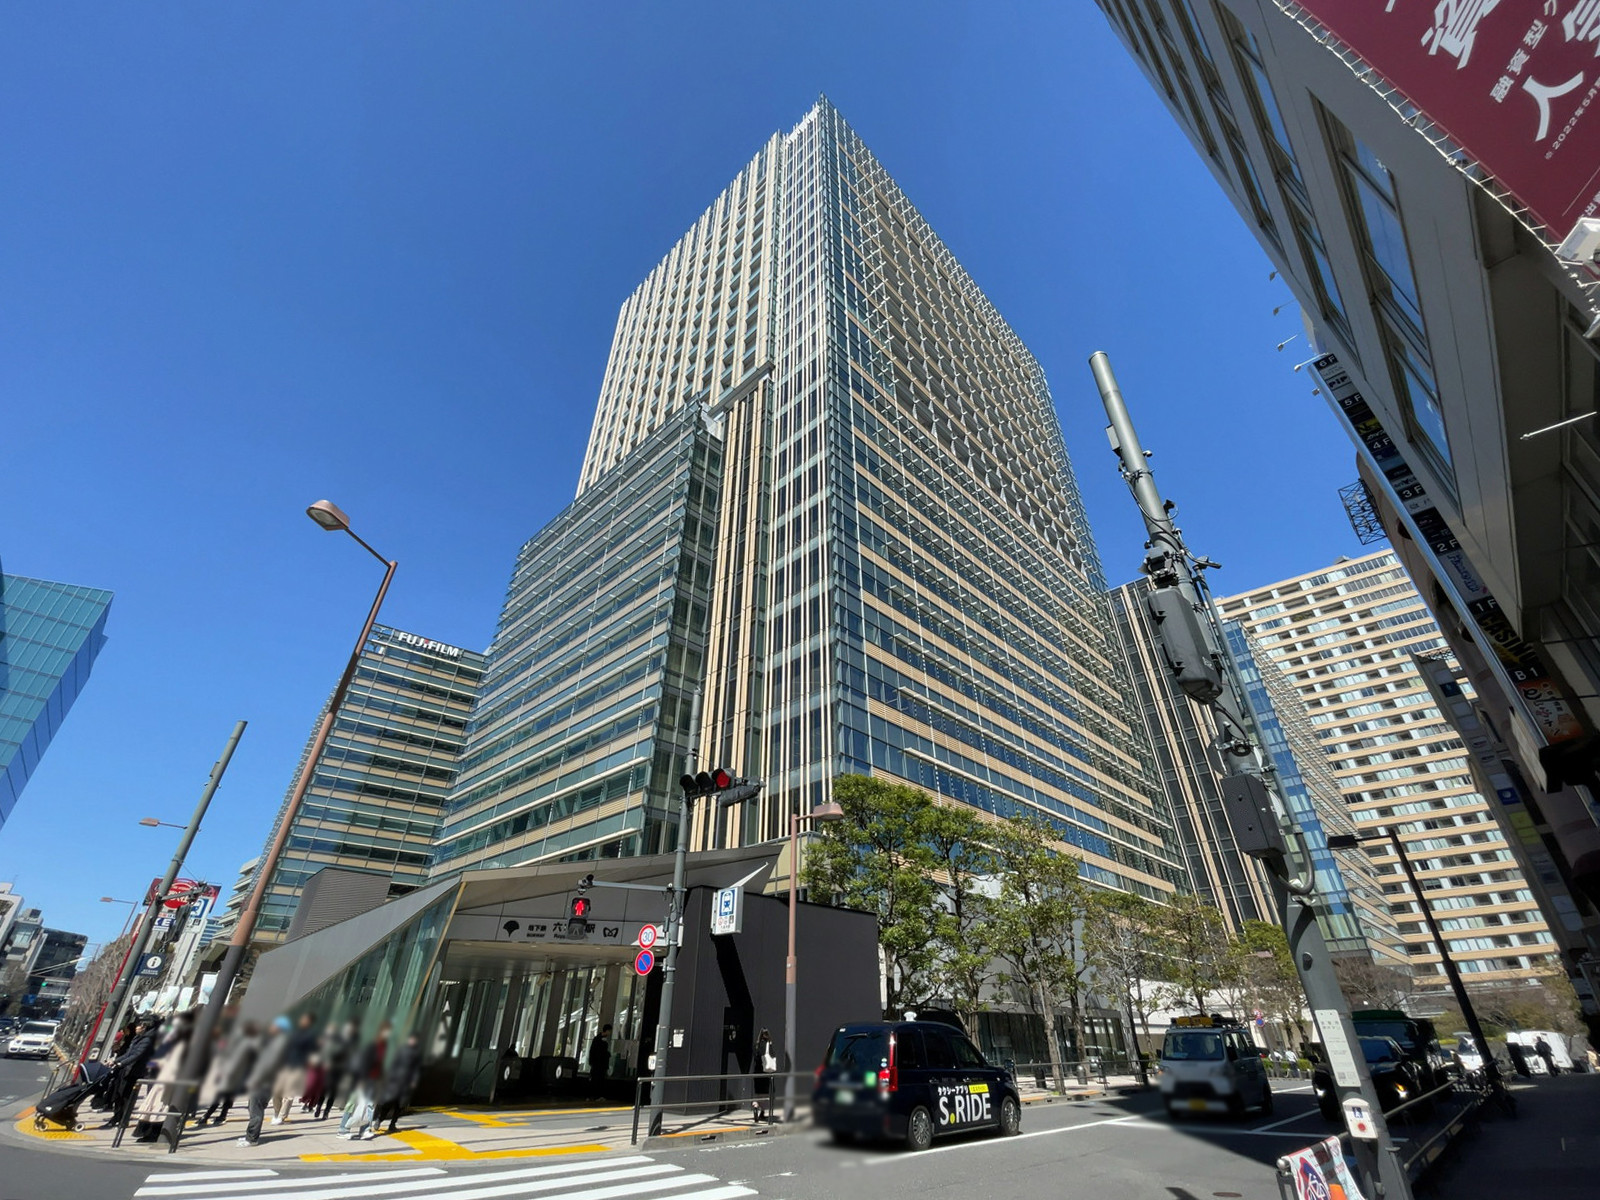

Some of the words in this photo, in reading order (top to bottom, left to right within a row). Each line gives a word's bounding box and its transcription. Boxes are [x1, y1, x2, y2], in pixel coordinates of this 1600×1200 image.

[398, 632, 459, 657] FUJIFILM
[642, 931, 653, 943] 30
[939, 1095, 991, 1125] S.RIDE
